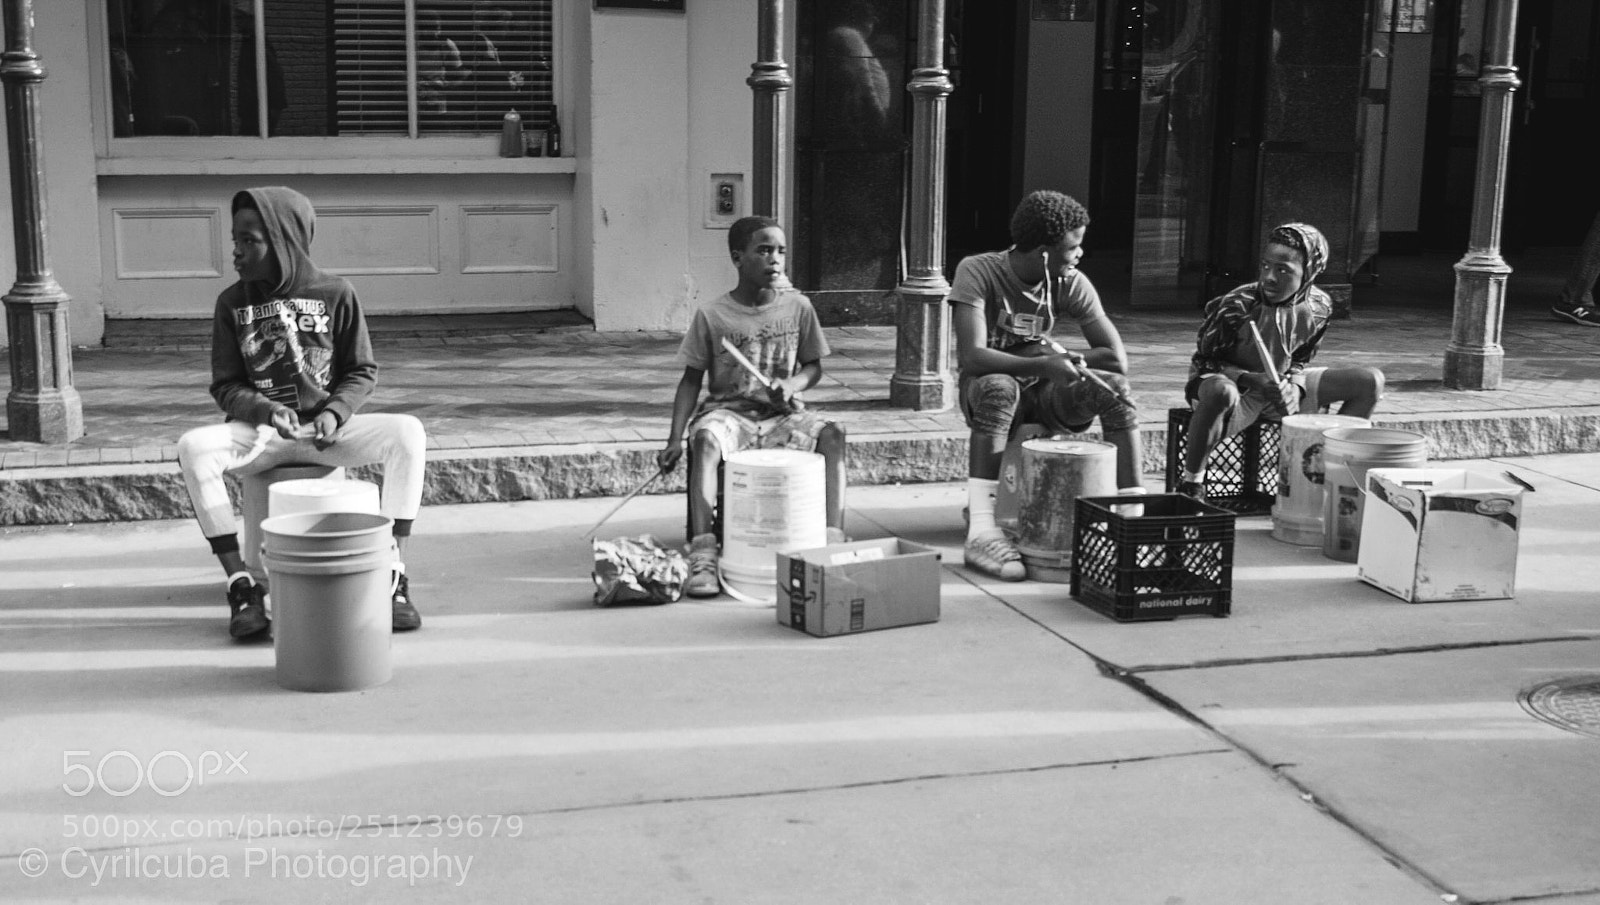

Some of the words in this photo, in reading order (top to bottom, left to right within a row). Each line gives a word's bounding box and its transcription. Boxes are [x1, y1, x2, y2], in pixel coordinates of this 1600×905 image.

[280, 311, 330, 333] Rex
[1139, 597, 1183, 609] national
[1185, 596, 1213, 606] dairy
